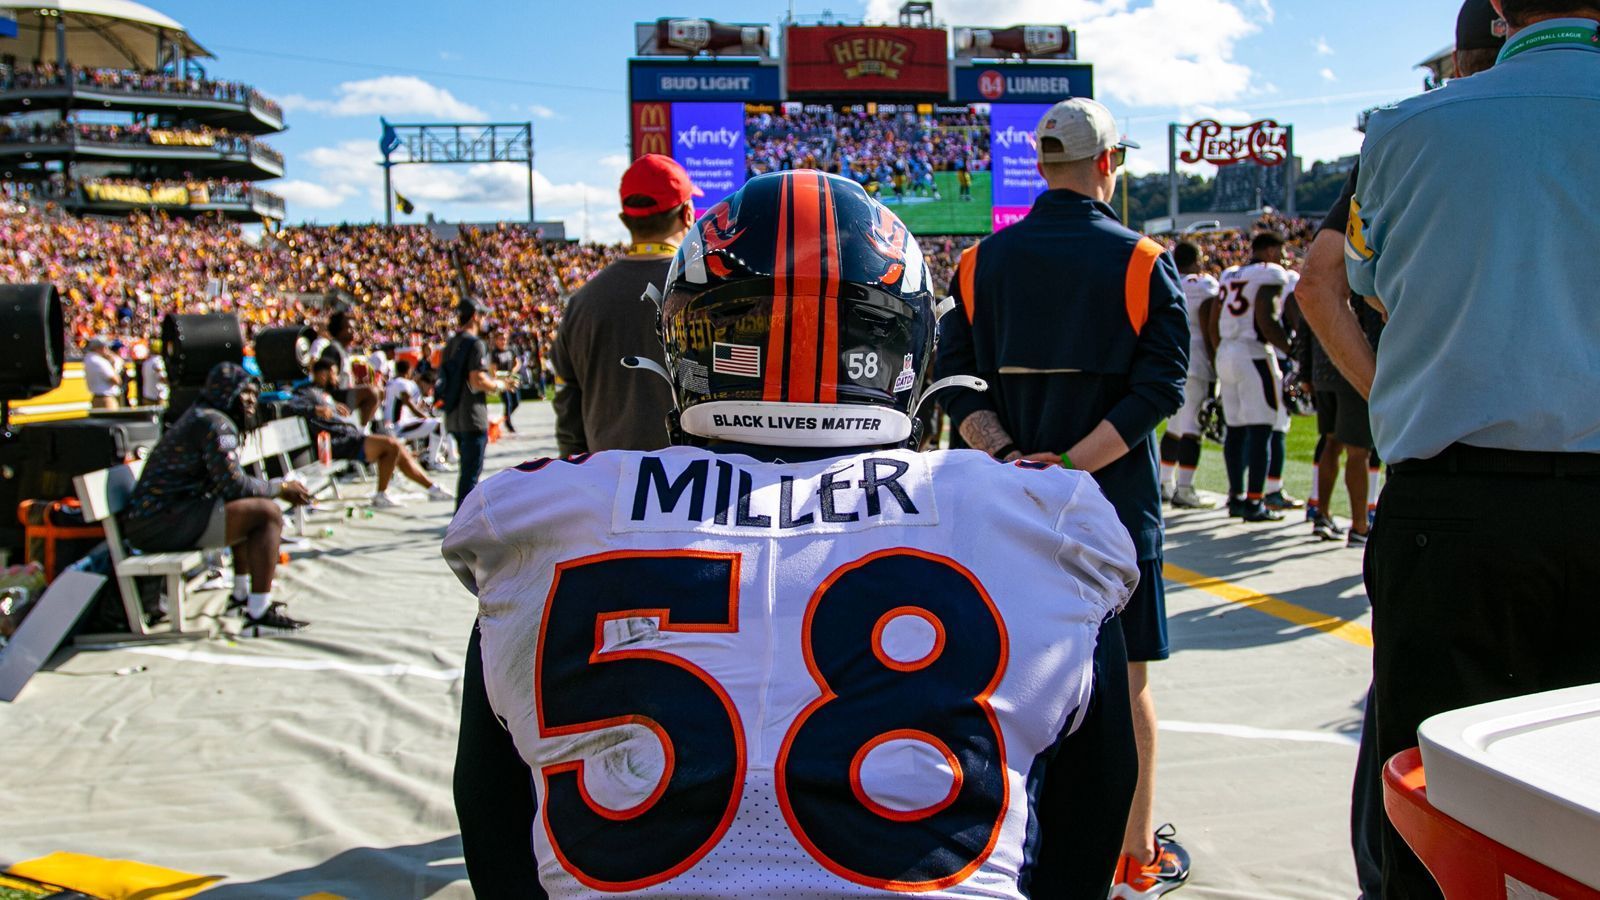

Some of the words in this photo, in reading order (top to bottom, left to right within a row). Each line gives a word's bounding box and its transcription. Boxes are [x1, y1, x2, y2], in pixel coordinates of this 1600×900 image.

[1526, 34, 1556, 45] FOOTBALL
[833, 38, 907, 65] HEINZ
[660, 76, 698, 90] BUD
[700, 76, 750, 90] LIGHT
[981, 76, 1002, 94] 84
[1006, 76, 1070, 94] LUMBER
[678, 125, 740, 150] xfinity
[686, 157, 701, 167] The
[848, 352, 879, 379] 58
[713, 414, 763, 428] BLACK
[768, 415, 817, 430] LIVES
[821, 418, 881, 431] MATTER
[630, 456, 919, 529] MILLER
[534, 547, 1009, 893] 58
